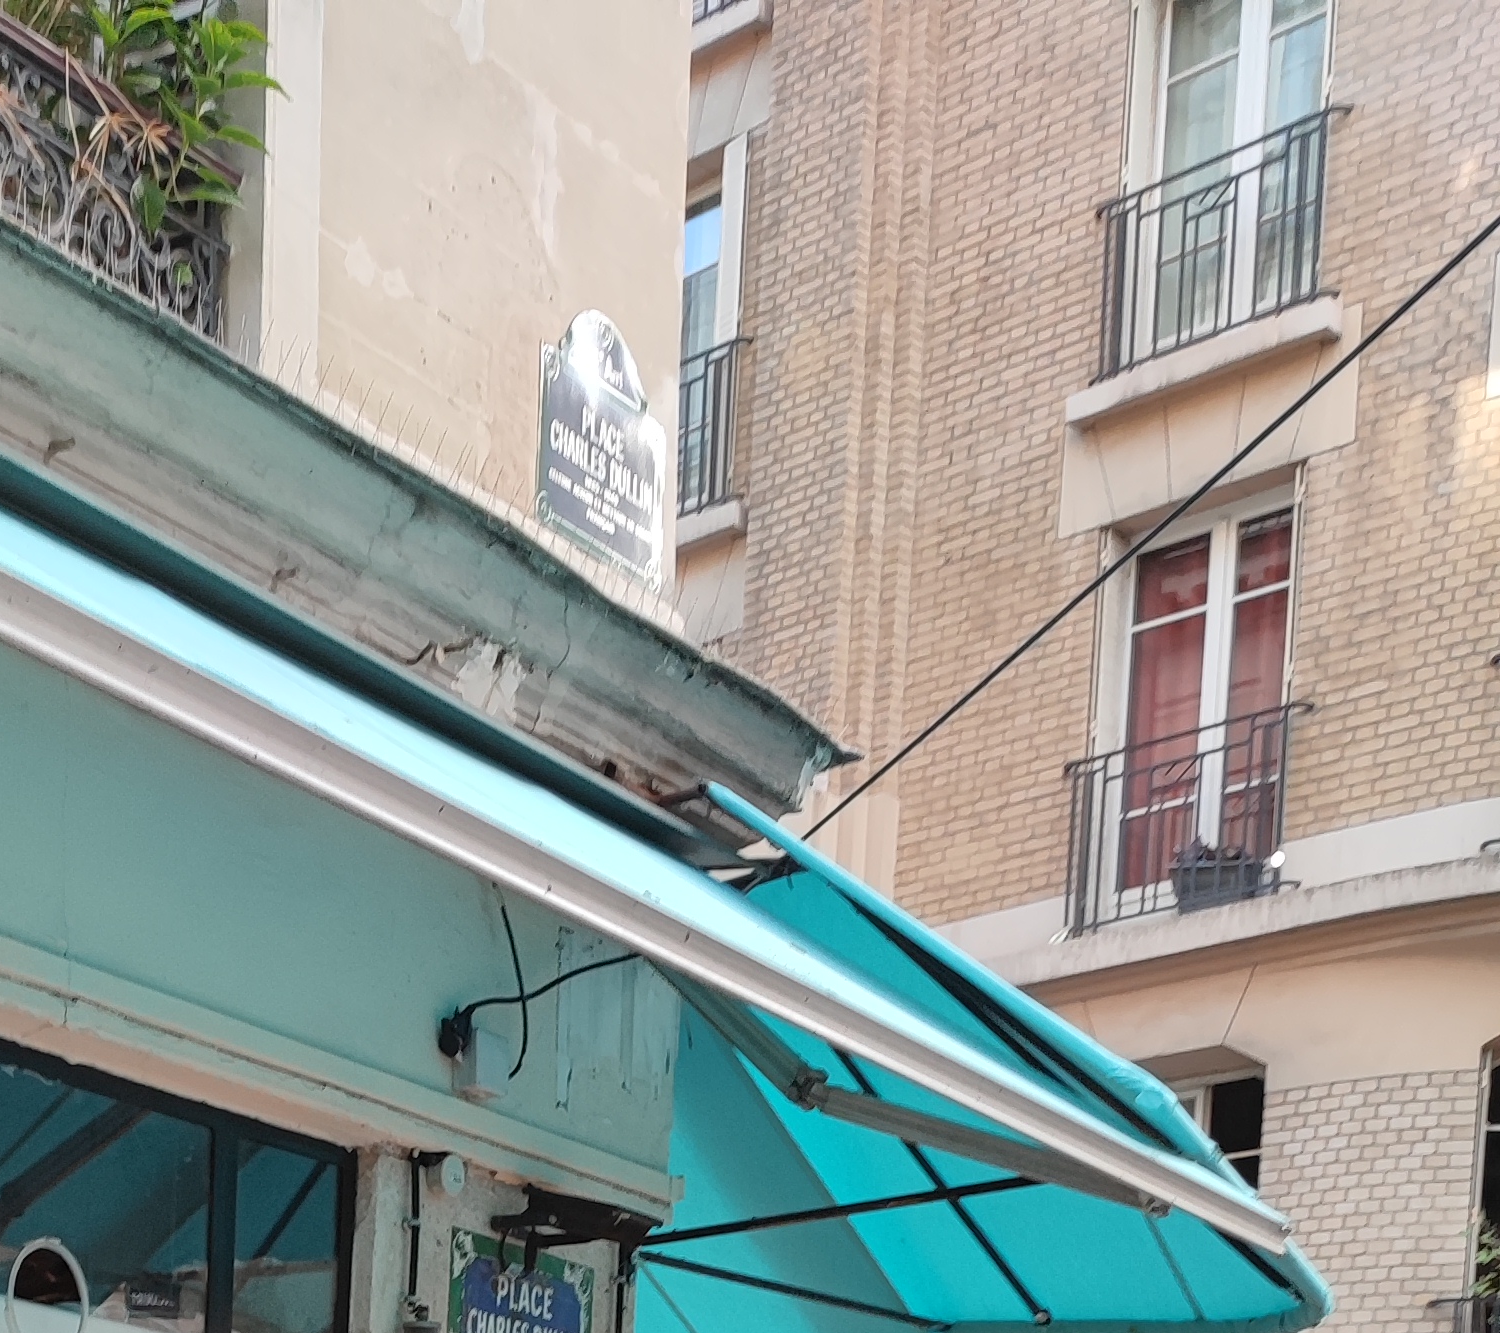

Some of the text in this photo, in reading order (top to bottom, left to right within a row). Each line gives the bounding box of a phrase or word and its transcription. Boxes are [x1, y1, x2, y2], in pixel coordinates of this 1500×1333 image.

[549, 417, 607, 482] CHARLES
[581, 404, 625, 464] PLACE
[609, 456, 653, 516] DULLIN
[495, 1274, 555, 1321] PLACE
